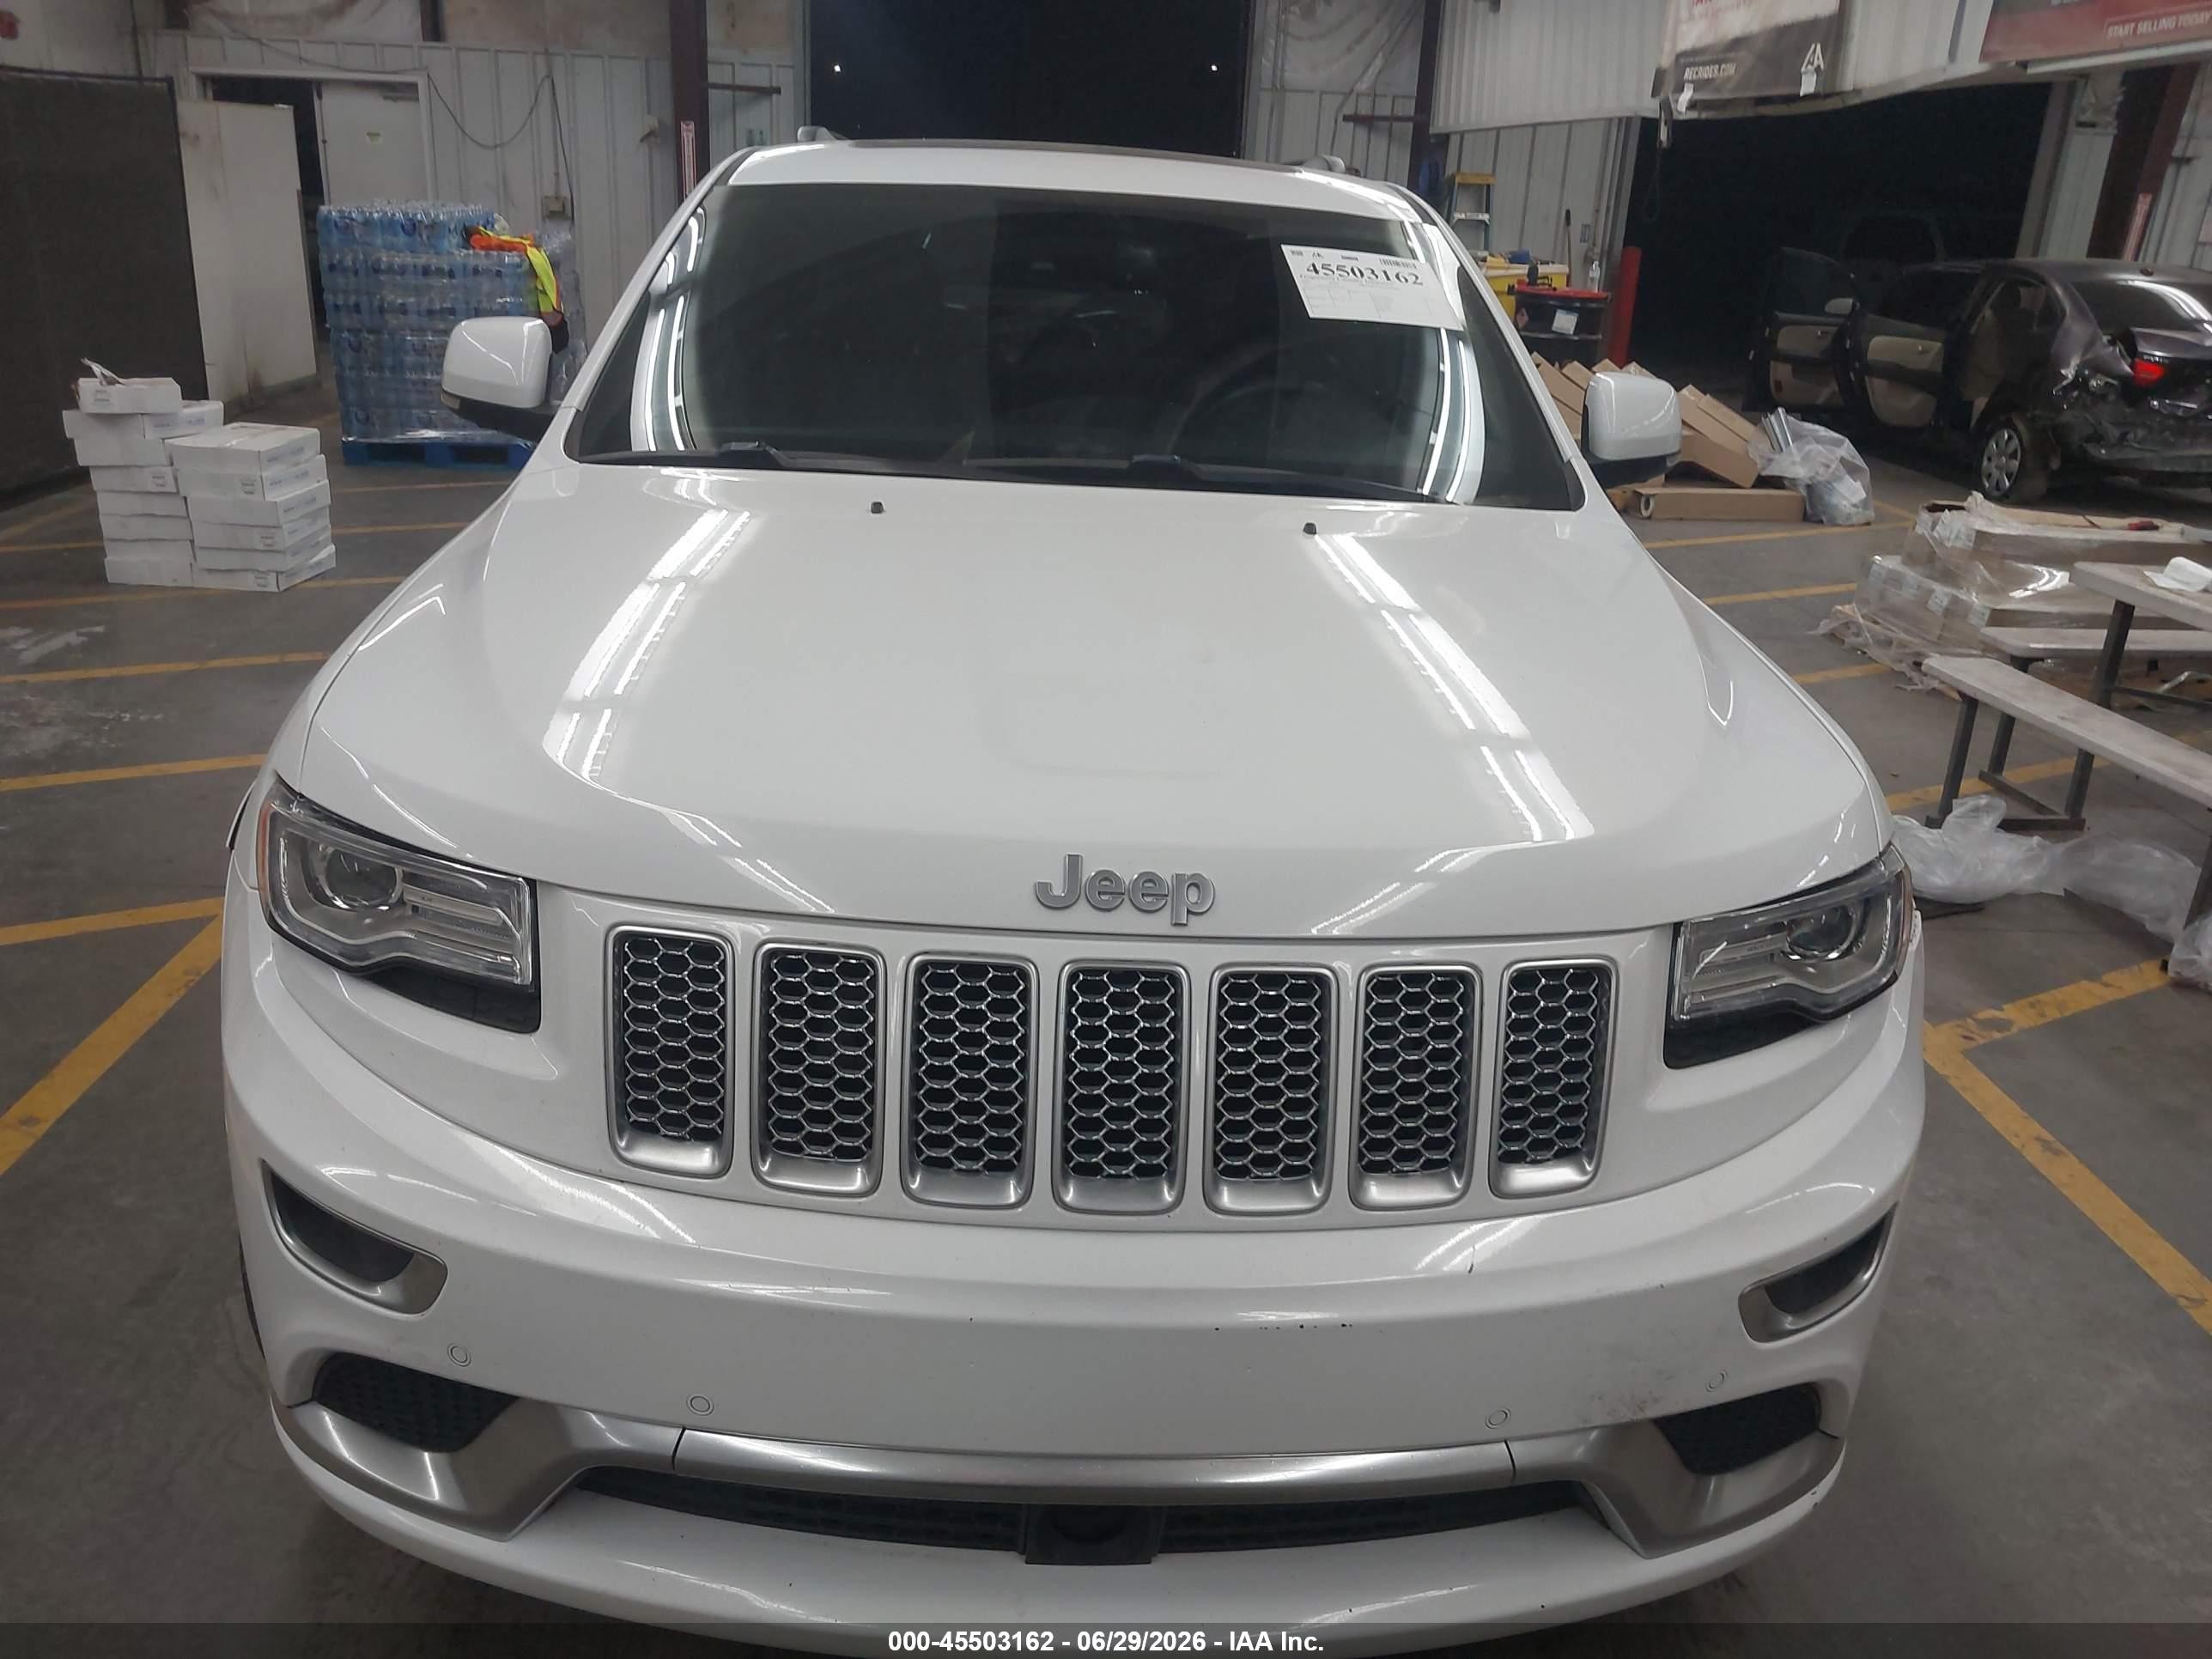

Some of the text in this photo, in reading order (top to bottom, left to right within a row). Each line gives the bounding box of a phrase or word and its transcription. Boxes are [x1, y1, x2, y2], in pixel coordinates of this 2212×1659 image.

[2108, 22, 2136, 37] START
[2136, 17, 2176, 33] SELLING
[1306, 262, 1424, 286] 45503162
[1035, 853, 1216, 927] Jeep
